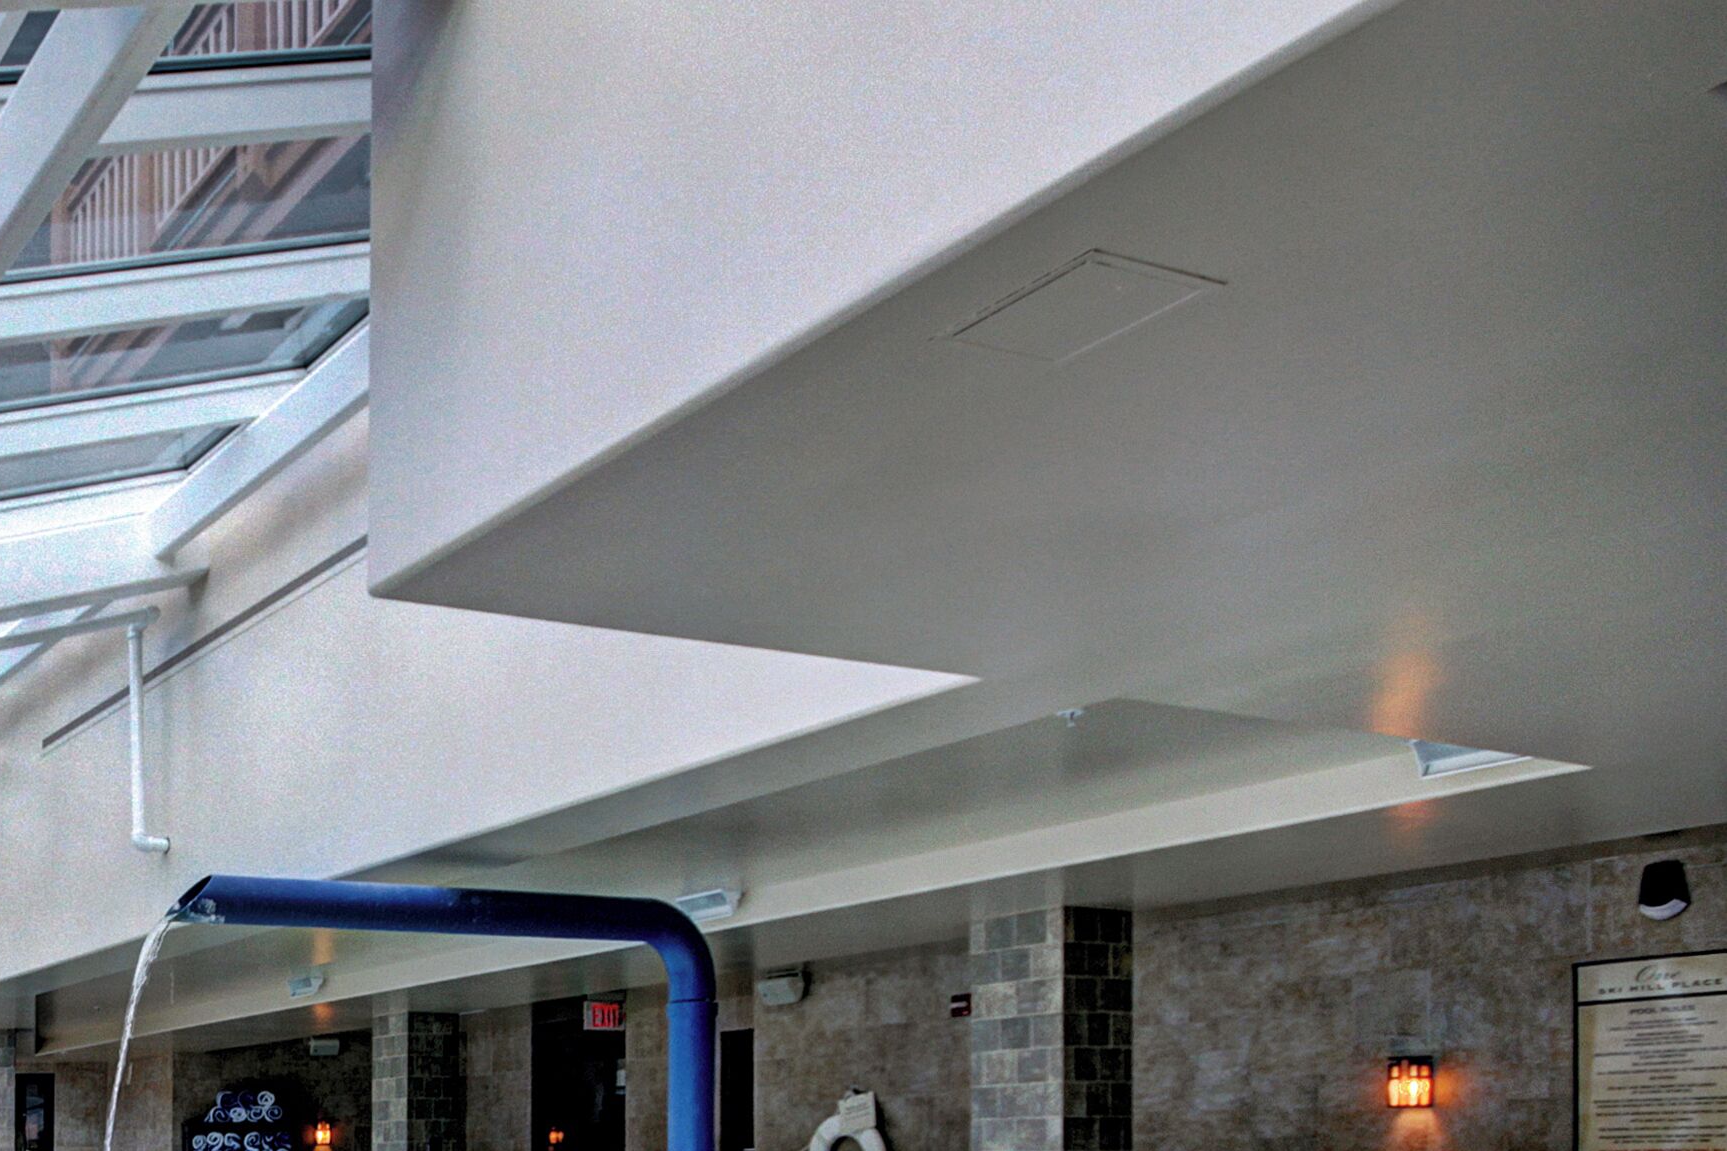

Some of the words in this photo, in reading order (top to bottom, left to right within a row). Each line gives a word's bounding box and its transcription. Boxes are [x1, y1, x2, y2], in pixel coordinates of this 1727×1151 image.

[1598, 987, 1623, 995] SKI
[1629, 983, 1665, 993] HILL
[1671, 977, 1723, 989] PLACE
[592, 1004, 619, 1028] EXIT
[1629, 1008, 1658, 1016] POOL
